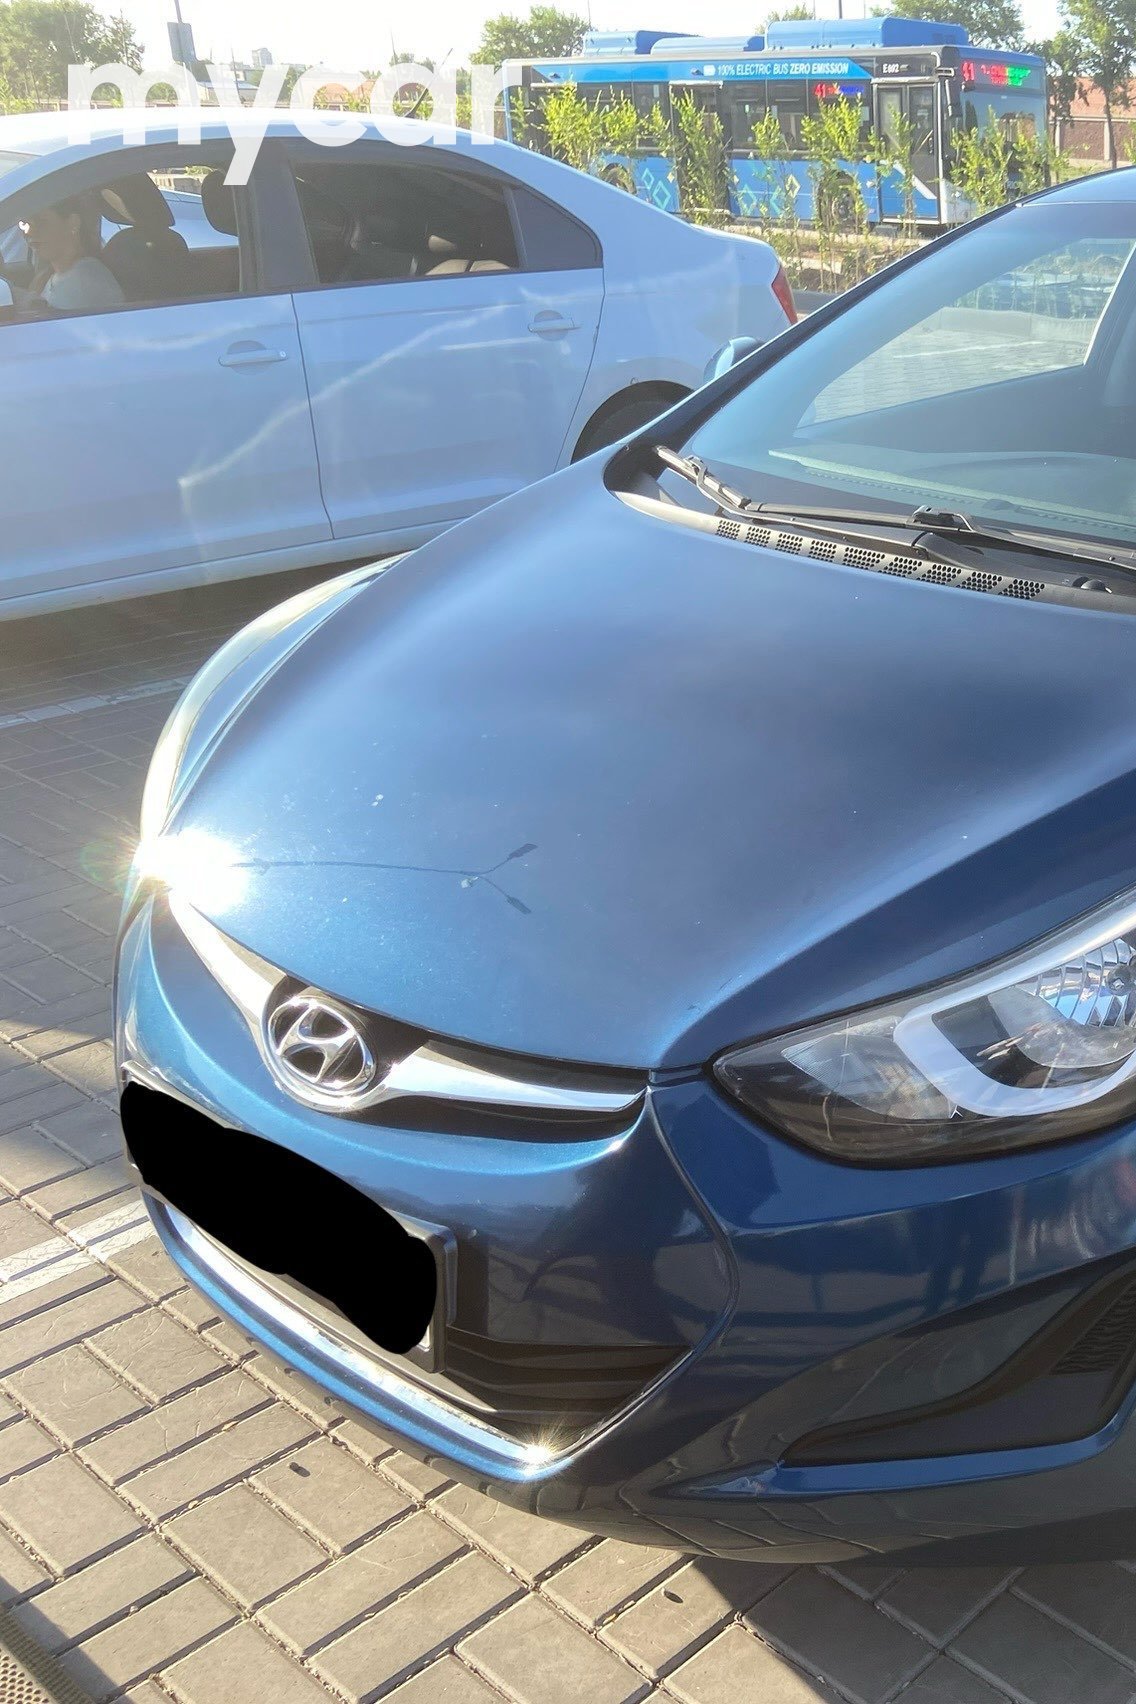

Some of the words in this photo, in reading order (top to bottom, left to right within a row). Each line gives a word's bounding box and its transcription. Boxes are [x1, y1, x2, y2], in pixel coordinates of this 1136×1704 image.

[717, 64, 735, 76] 100%
[736, 64, 772, 75] ELECTRIC
[773, 63, 788, 75] BUS
[789, 63, 811, 75] ZERO
[811, 62, 849, 75] EMISSION
